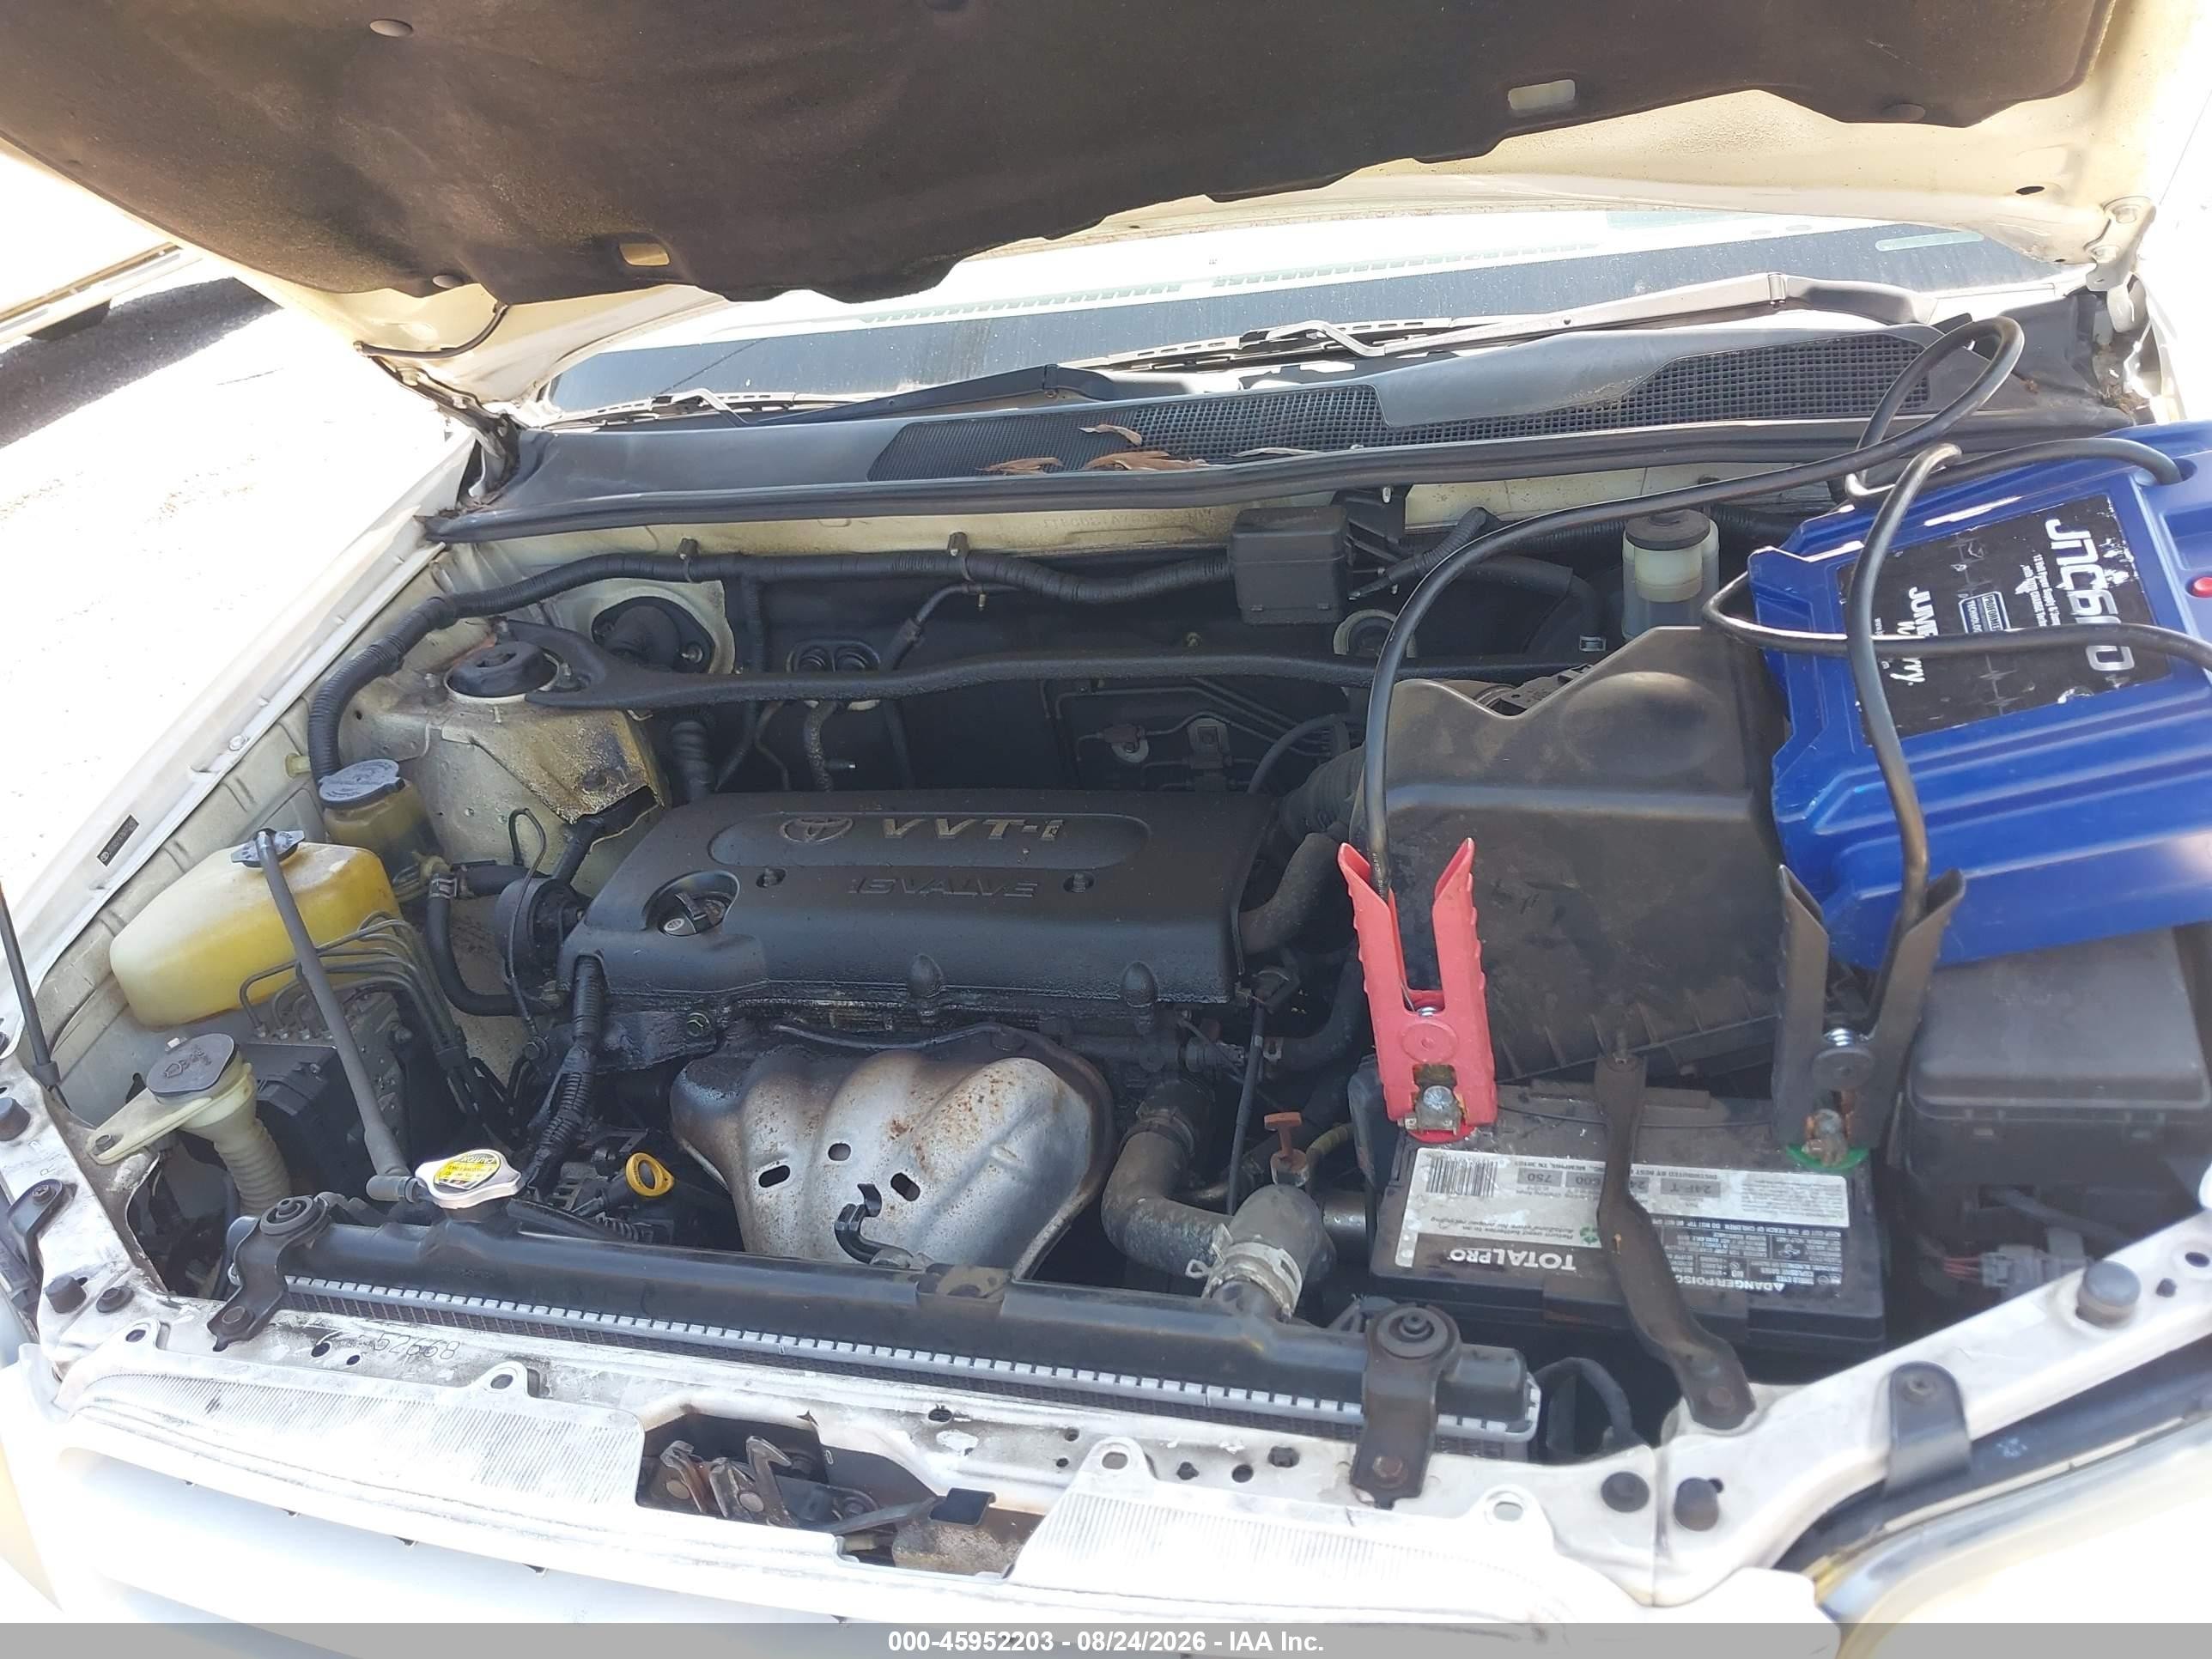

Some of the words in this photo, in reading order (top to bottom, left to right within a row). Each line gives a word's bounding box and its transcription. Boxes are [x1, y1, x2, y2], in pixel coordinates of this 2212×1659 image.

[2029, 590, 2045, 613] CHARGE
[2041, 587, 2057, 608] Supply
[882, 817, 1065, 841] VVT-i
[1527, 1173, 1553, 1183] 750
[1670, 1183, 1711, 1194] 24F-T
